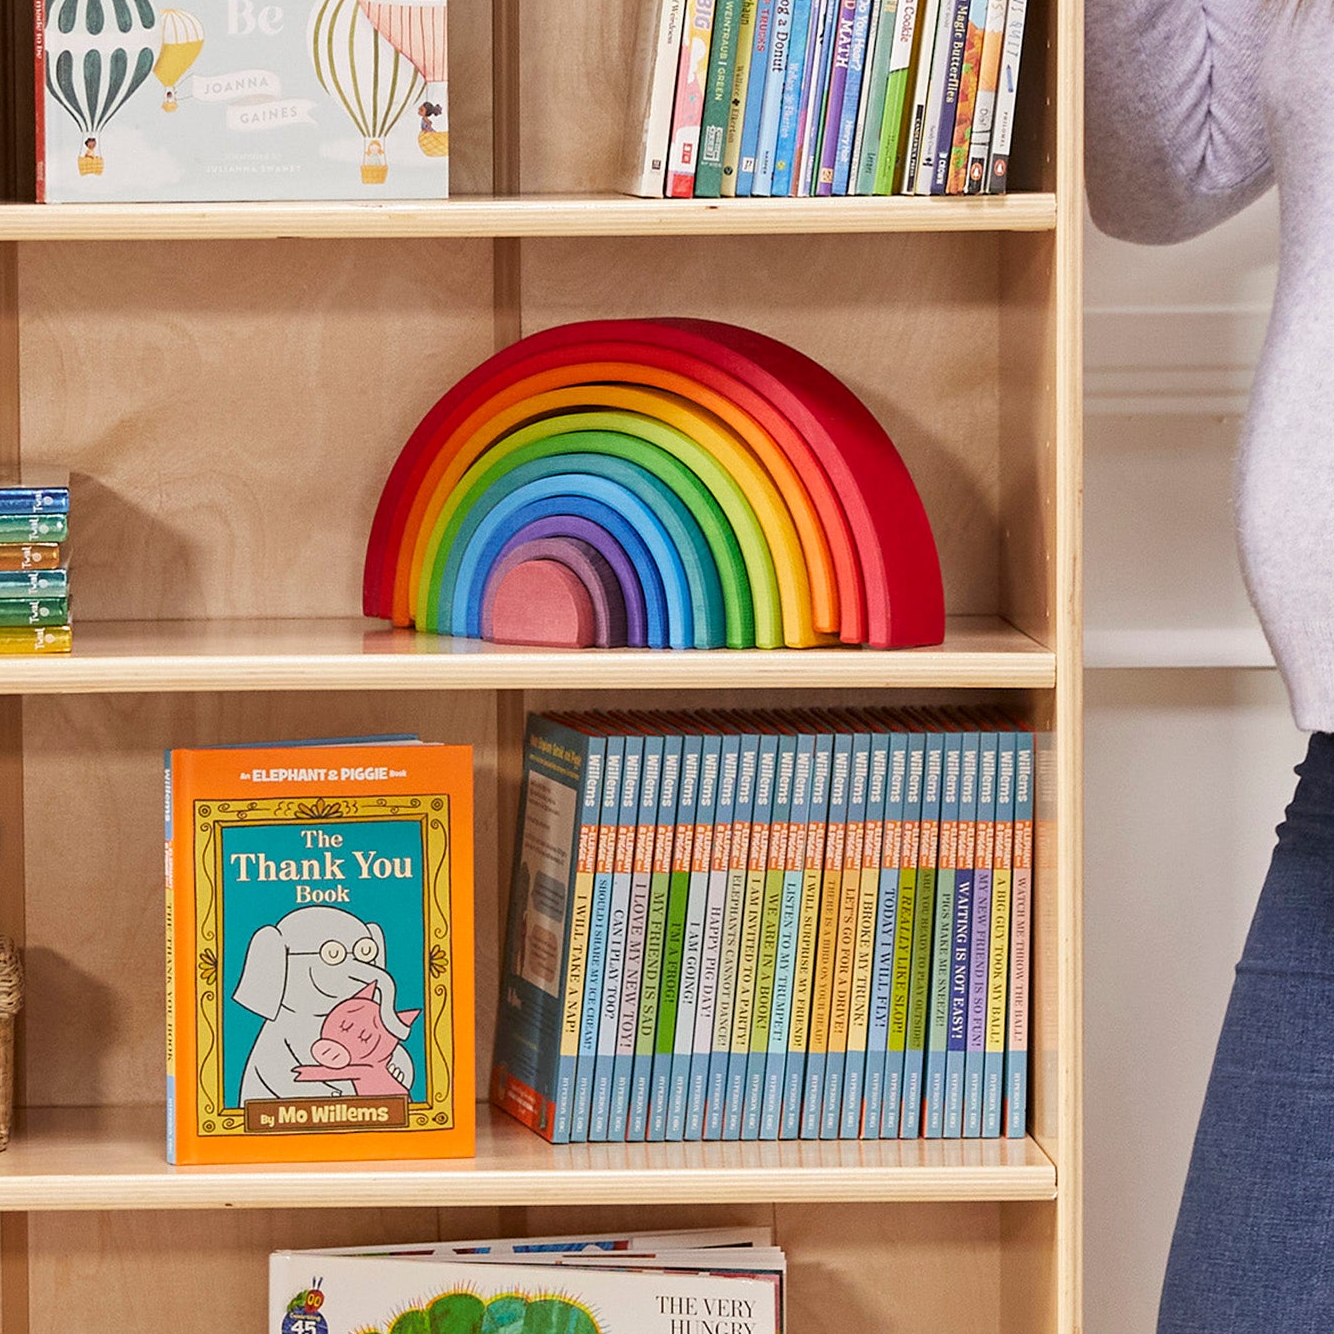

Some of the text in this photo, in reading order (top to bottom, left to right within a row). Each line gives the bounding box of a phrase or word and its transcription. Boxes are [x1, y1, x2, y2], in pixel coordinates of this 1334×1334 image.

[777, 18, 787, 26] a
[900, 6, 915, 41] Cookie
[953, 5, 968, 35] Magic
[714, 1, 733, 100] WEINTRAUB GREEN
[771, 31, 788, 72] Donut
[835, 18, 854, 67] MATH
[1005, 20, 1022, 56] QUIT
[205, 77, 269, 94] JOANNA
[944, 41, 963, 103] Butterflies
[240, 107, 297, 123] GAINES
[252, 769, 326, 782] ELEPHANT
[328, 769, 338, 780] &
[341, 767, 387, 781] PIGGIE
[585, 755, 600, 807] Willems
[682, 754, 699, 807] Willems
[778, 752, 793, 805] Willems
[1018, 750, 1031, 803] Willems
[301, 830, 343, 848] The
[231, 851, 413, 881] Thank You
[296, 885, 350, 903] Book
[573, 904, 585, 939] WILL
[881, 888, 894, 936] TODAY
[569, 945, 582, 982] TAKE
[640, 892, 664, 1035] MY FRIEND IS SAD
[772, 882, 796, 1041] LISTEN TO MY TRUMPET!
[877, 952, 890, 991] WILL
[950, 881, 969, 1037] WAITING IS NOT EASY!
[568, 987, 578, 995] A
[565, 1001, 577, 1033] NAP!
[874, 996, 887, 1027] FLY!
[260, 1104, 389, 1127] By Mo Willems
[656, 1296, 756, 1318] THE VERY
